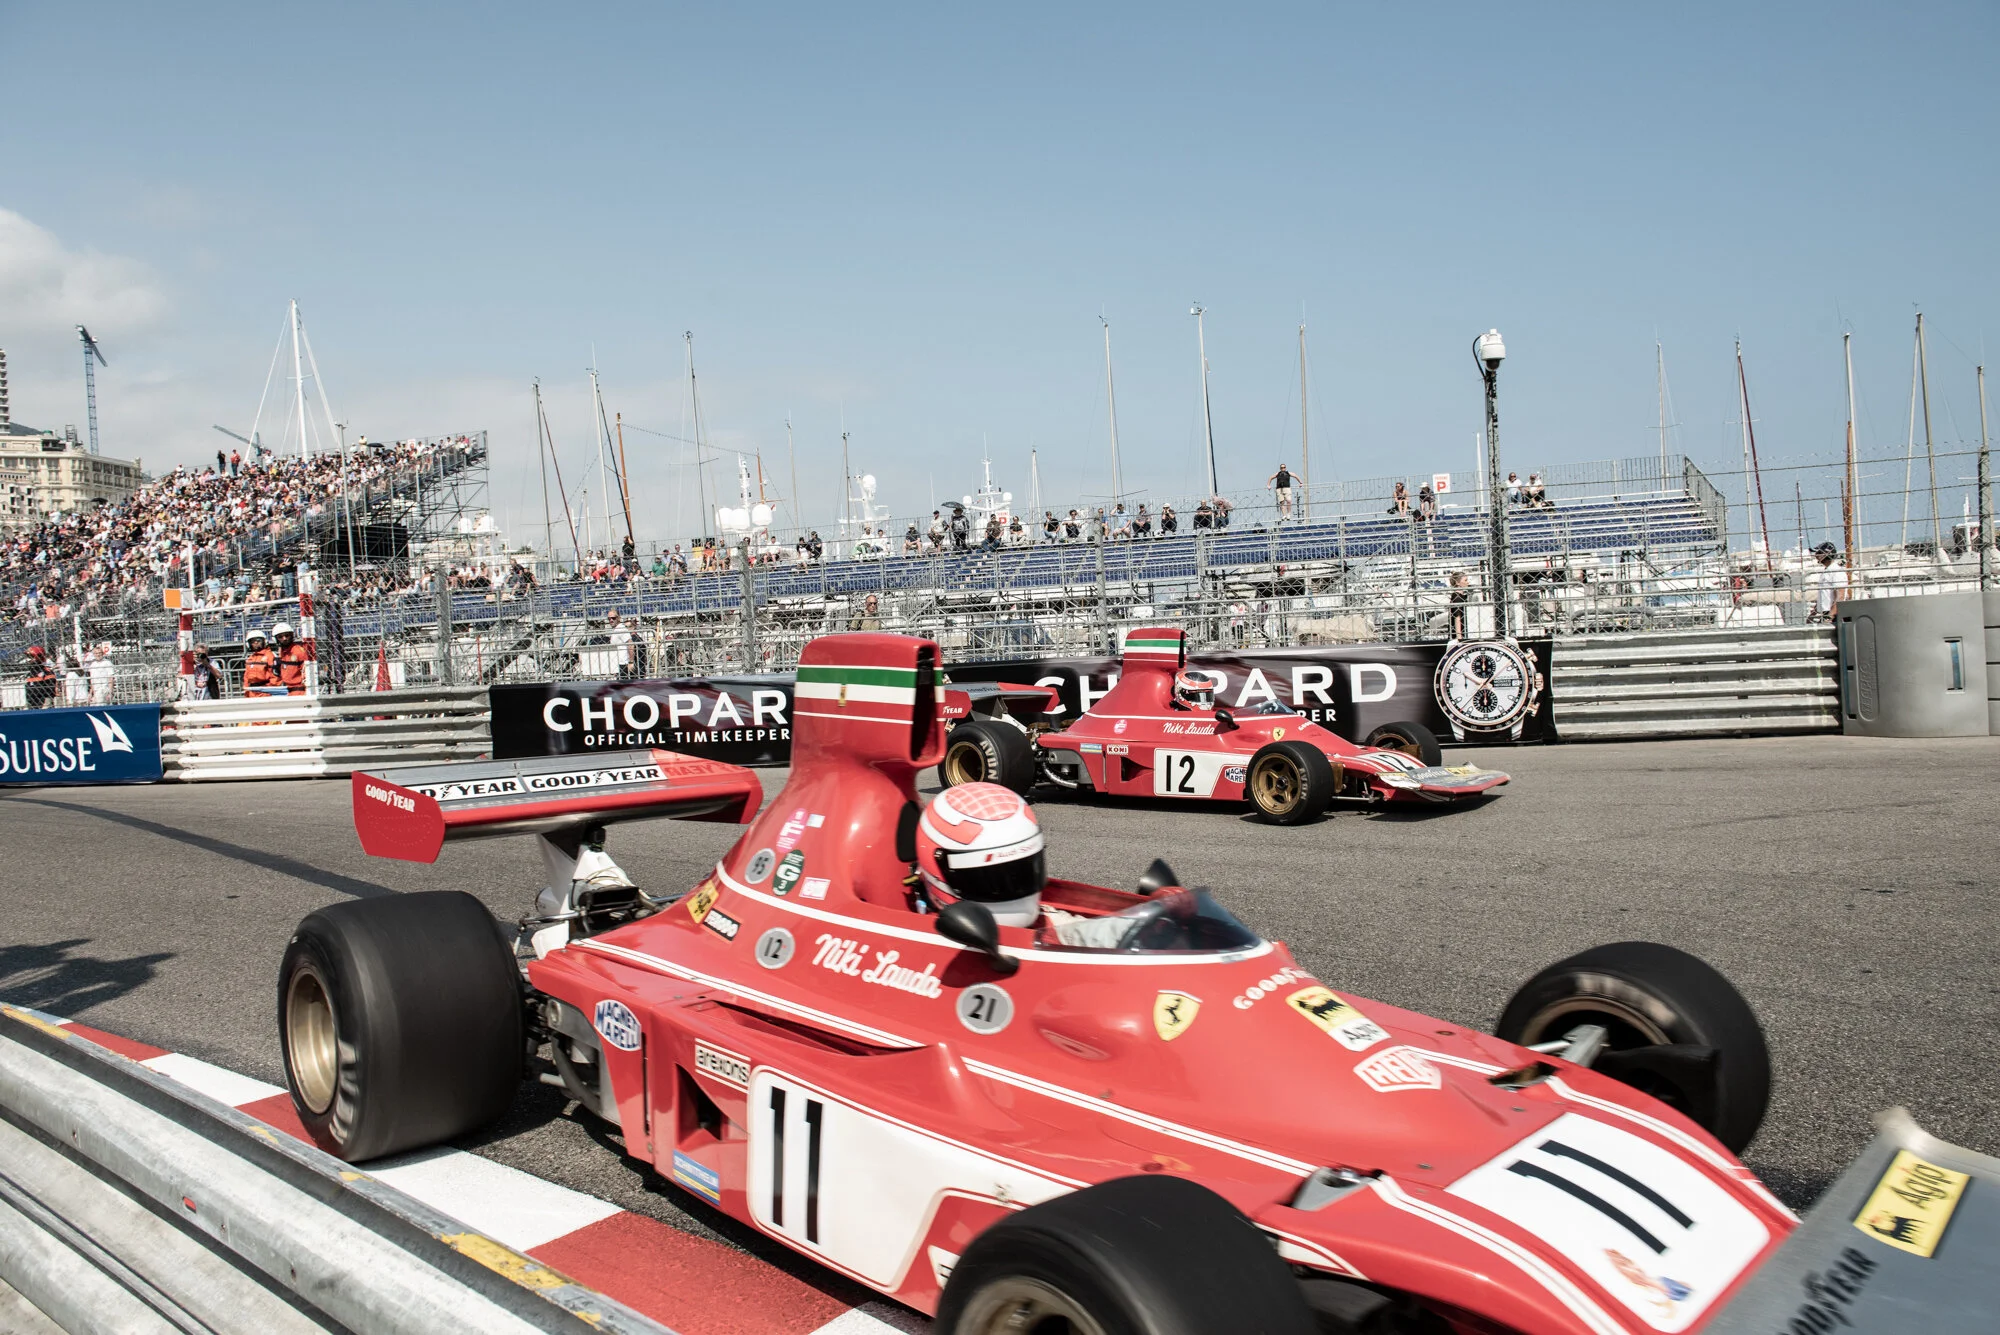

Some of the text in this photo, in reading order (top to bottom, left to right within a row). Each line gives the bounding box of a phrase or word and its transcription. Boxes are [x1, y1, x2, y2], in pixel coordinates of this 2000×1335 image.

[1437, 481, 1446, 492] P
[1033, 663, 1397, 715] CHPARD
[543, 689, 789, 732] CHOPAR
[1162, 722, 1215, 736] Niki Lauda
[584, 728, 791, 746] OFFICIAL TIMEKEEPER
[456, 781, 517, 795] YEAR
[1165, 755, 1195, 794] 12
[764, 937, 783, 960] 12
[812, 933, 943, 999] Niki Lauda
[972, 993, 997, 1023] 21
[770, 1086, 824, 1246] 11
[1506, 1138, 1697, 1255] 11
[1889, 1162, 1953, 1210] Agip
